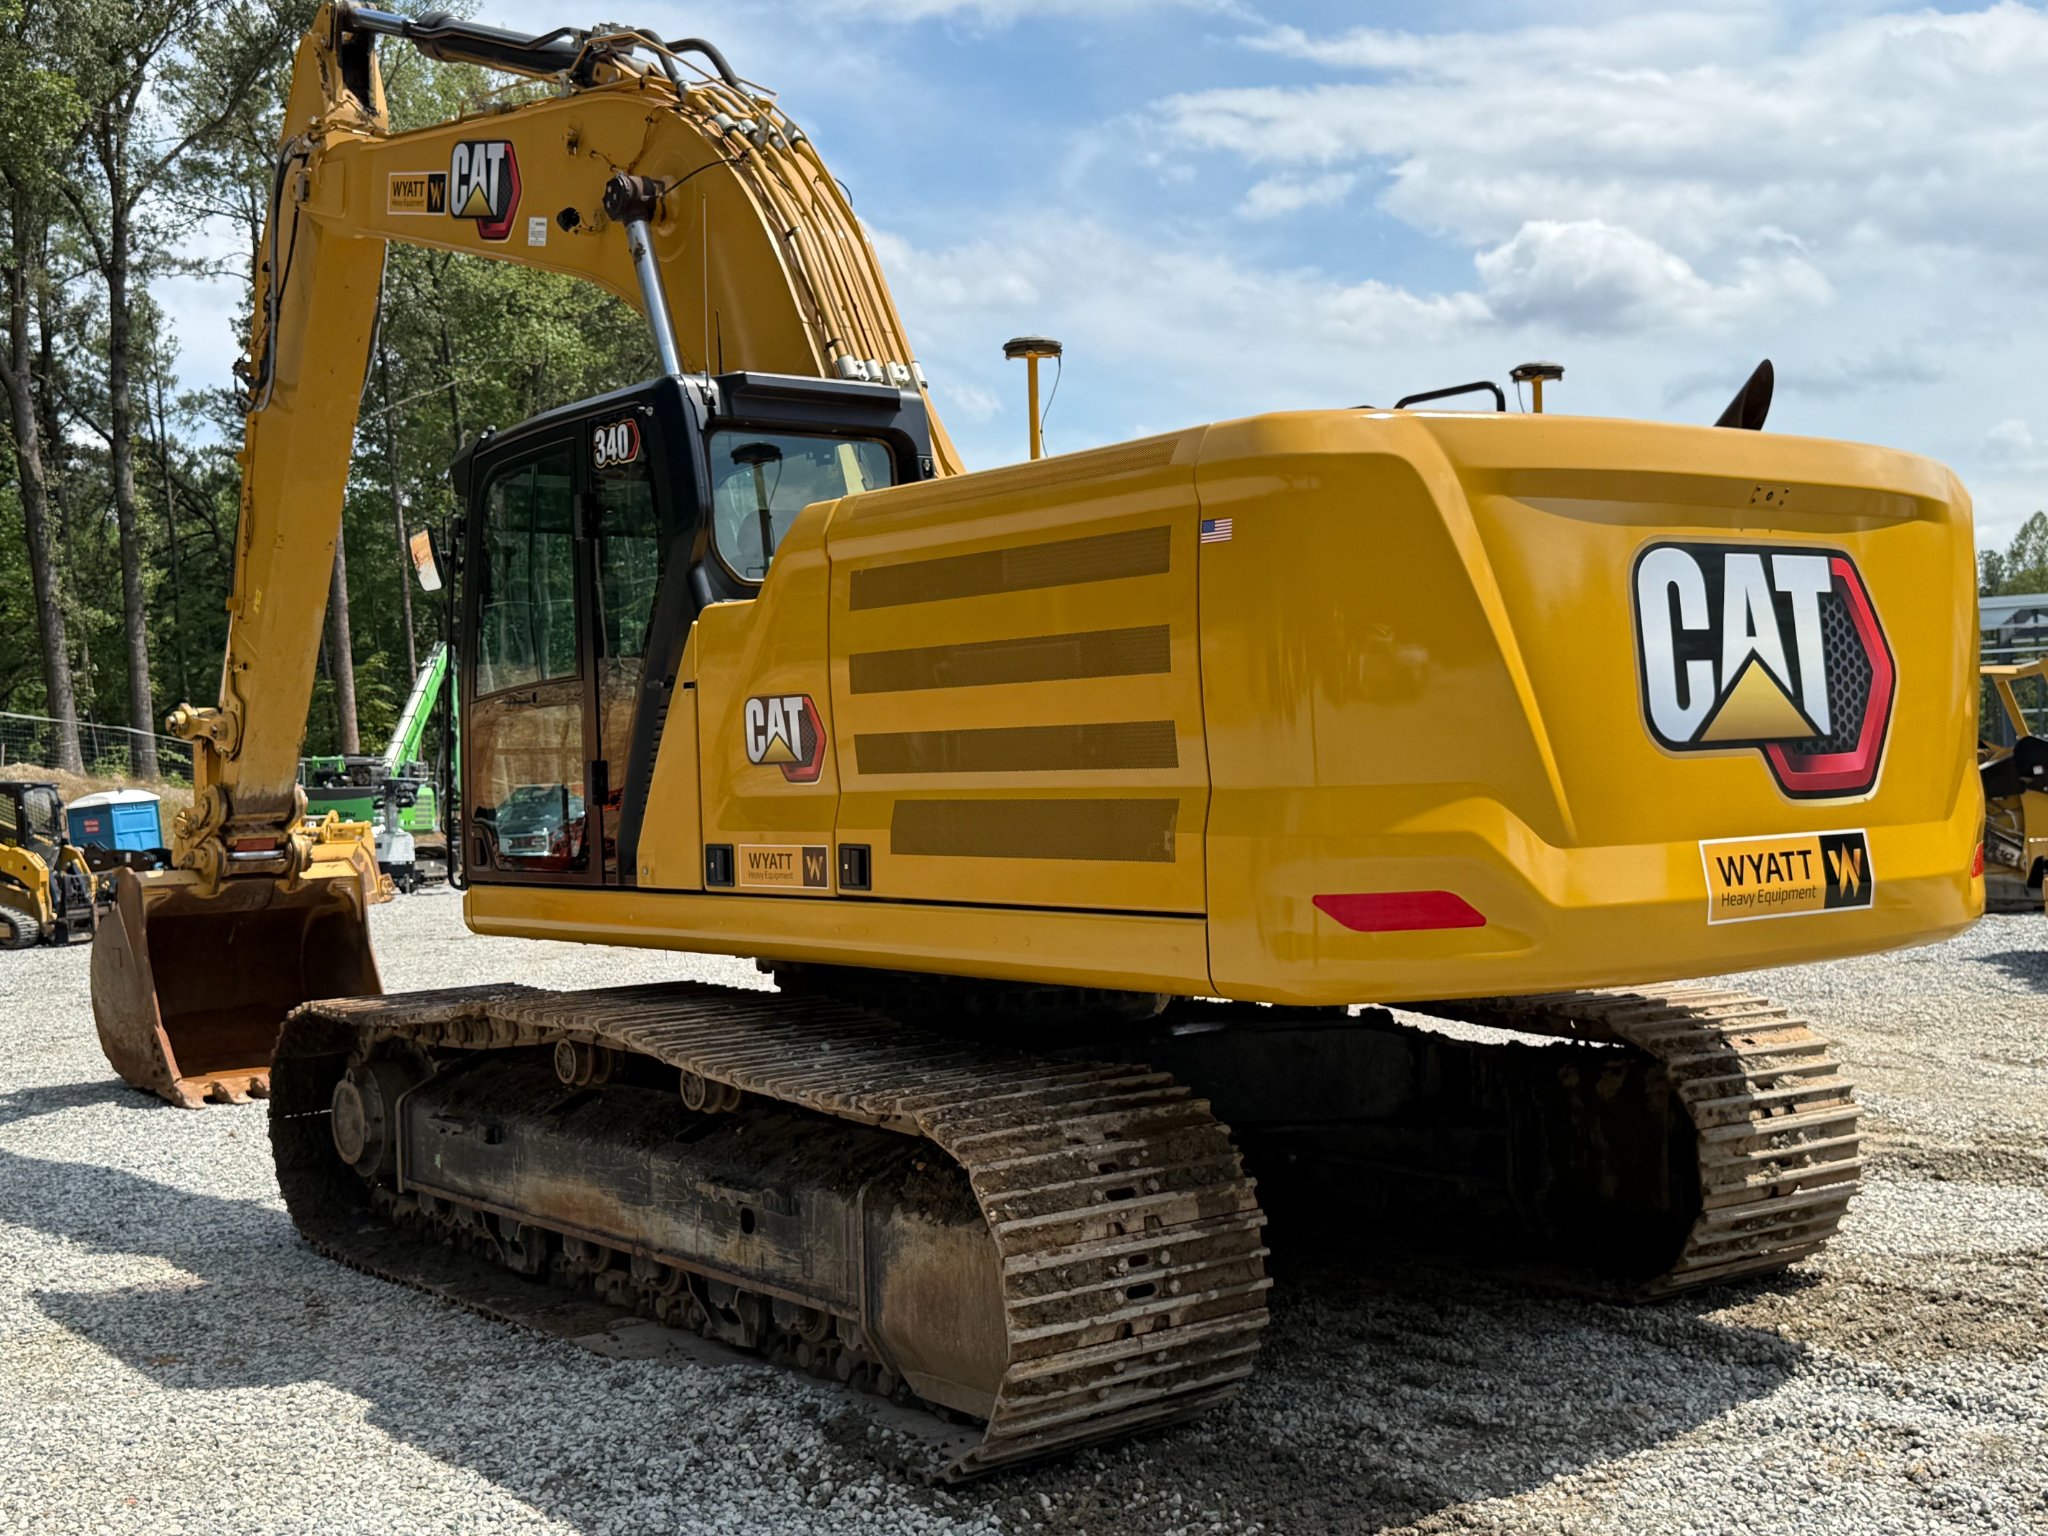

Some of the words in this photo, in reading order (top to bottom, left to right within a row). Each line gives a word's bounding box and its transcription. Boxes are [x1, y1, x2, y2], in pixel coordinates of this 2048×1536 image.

[393, 181, 425, 197] WYATT
[451, 143, 505, 216] CAT
[595, 423, 629, 465] 340
[1637, 547, 1832, 742] CAT
[745, 696, 803, 762] CAT
[748, 852, 793, 870] WYATT
[1716, 849, 1812, 887] WYATT
[1721, 892, 1756, 909] Heavy
[1757, 884, 1817, 907] Equipment
